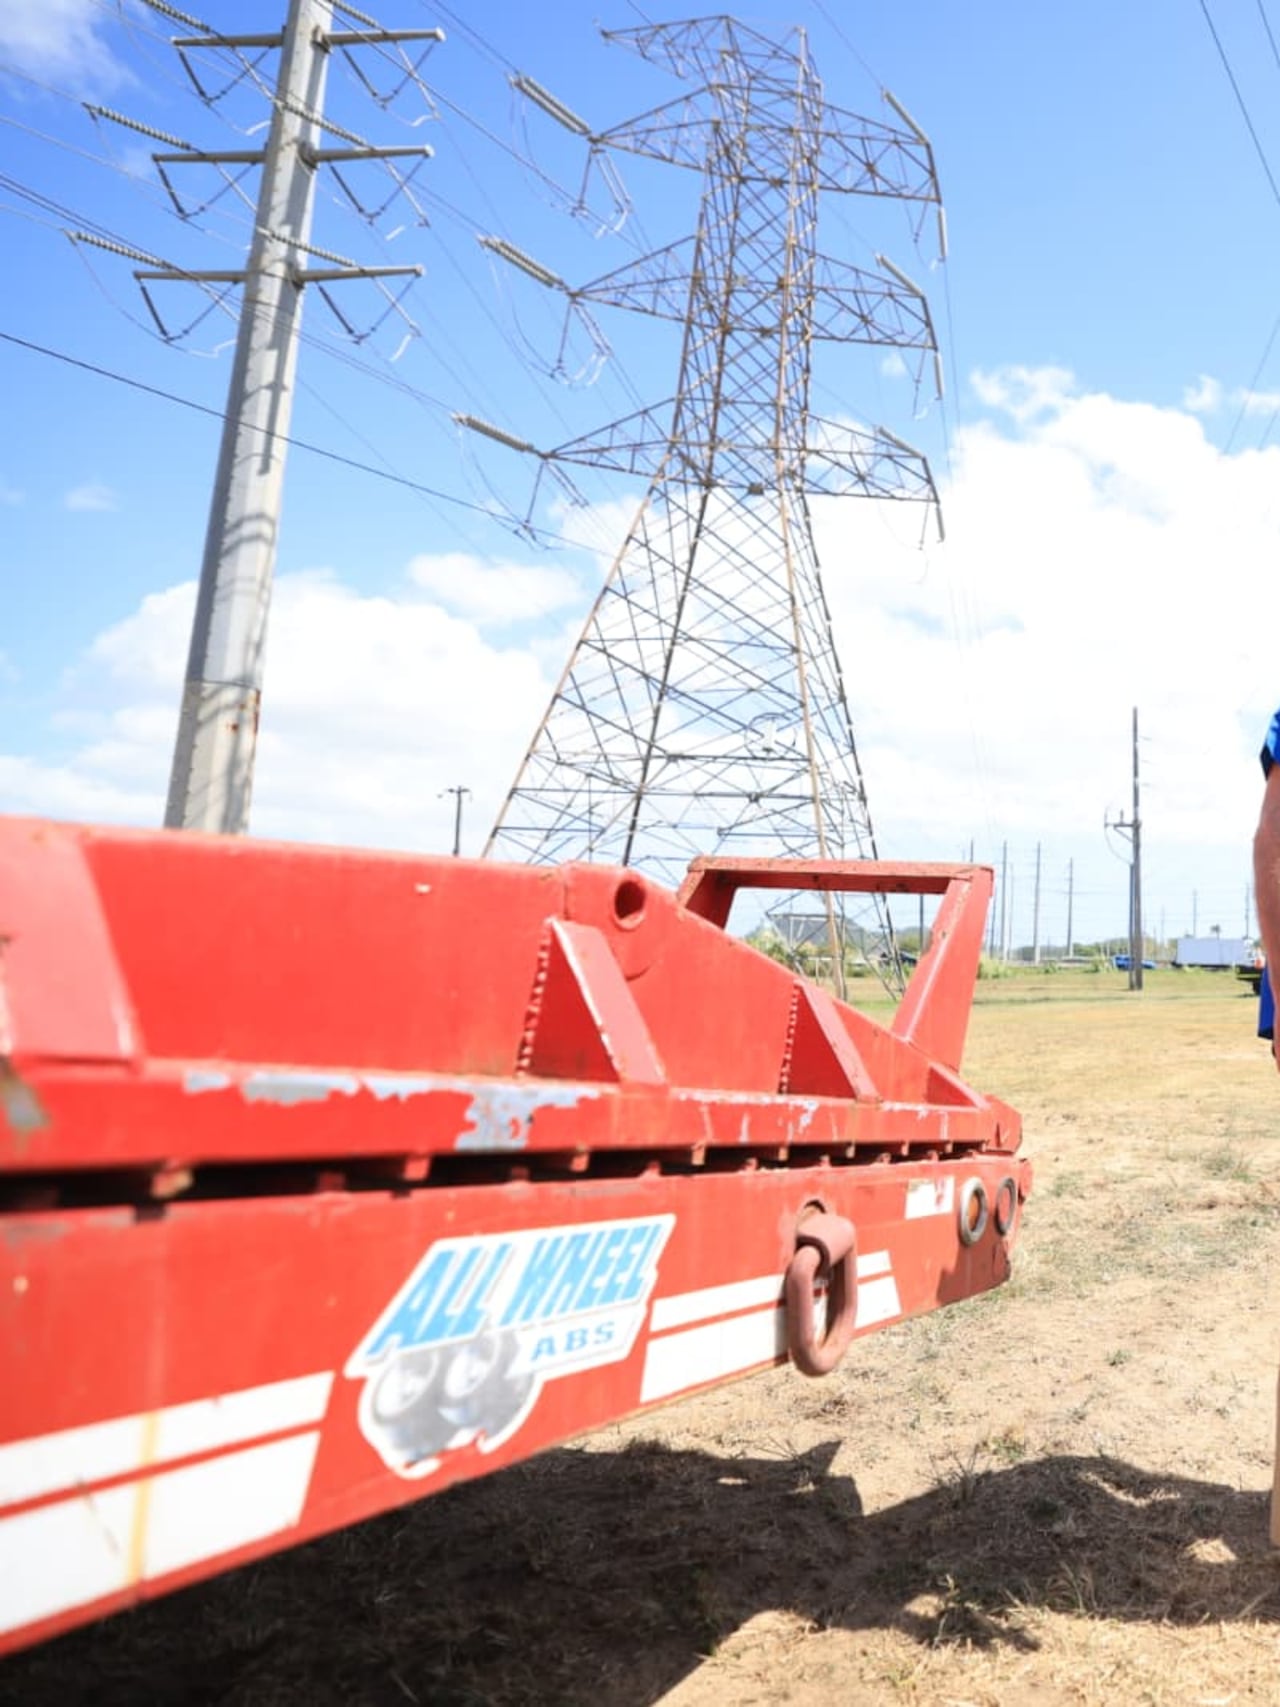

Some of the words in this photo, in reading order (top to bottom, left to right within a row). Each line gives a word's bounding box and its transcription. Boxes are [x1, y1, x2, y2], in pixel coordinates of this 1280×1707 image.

[366, 1243, 513, 1356] ALL
[499, 1224, 663, 1326] WHEEL
[531, 1321, 615, 1362] ABS
